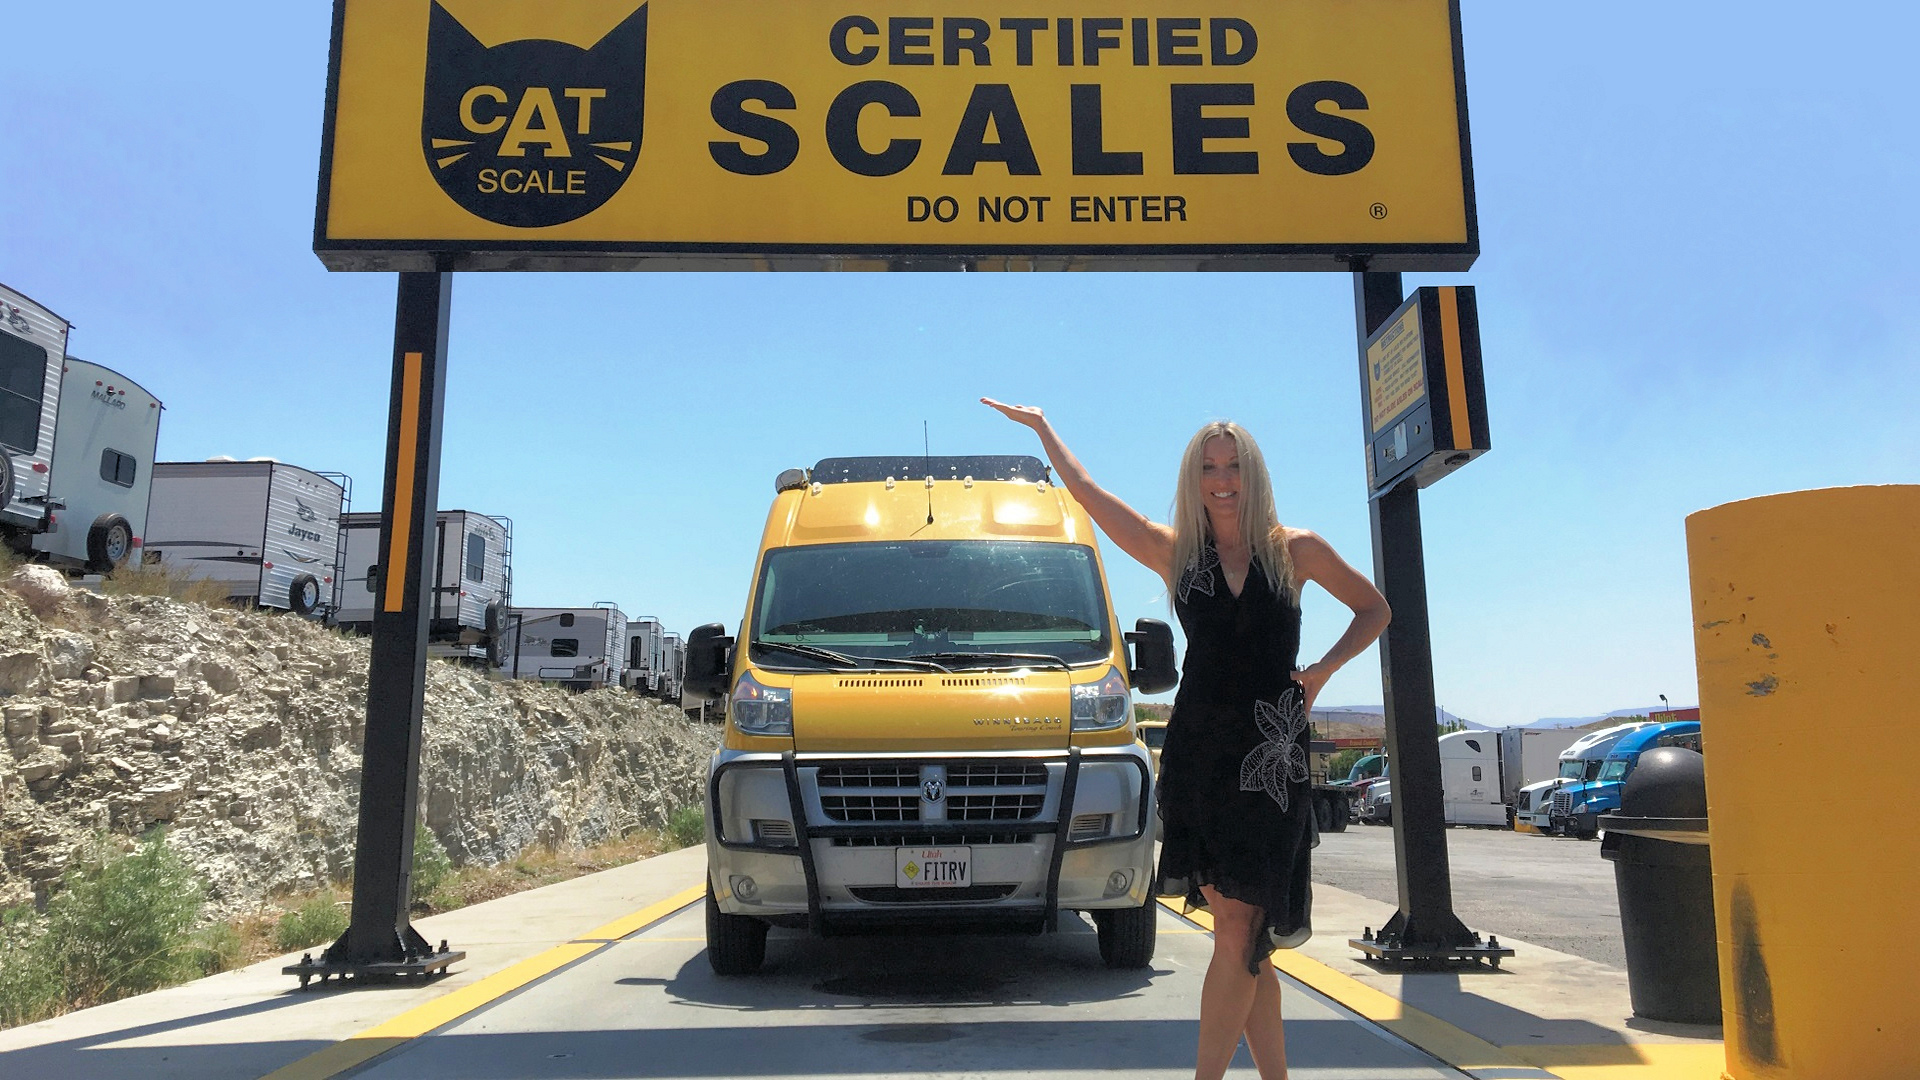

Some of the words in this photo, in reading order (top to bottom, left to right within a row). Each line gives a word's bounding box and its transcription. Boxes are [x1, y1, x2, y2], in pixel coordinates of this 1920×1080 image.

[830, 16, 1258, 66] CERTIFIED
[459, 86, 606, 158] CAT
[708, 80, 1375, 177] SCALES
[477, 169, 586, 194] SCALE
[907, 196, 959, 223] DO
[978, 196, 1051, 223] NOT
[1070, 196, 1187, 223] ENTER
[91, 390, 126, 410] MALLARD
[288, 523, 321, 542] Jayco
[973, 716, 1062, 726] WINNEBAGO
[1010, 724, 1038, 732] Touring
[921, 849, 943, 859] Utah
[924, 861, 967, 881] FITRV
